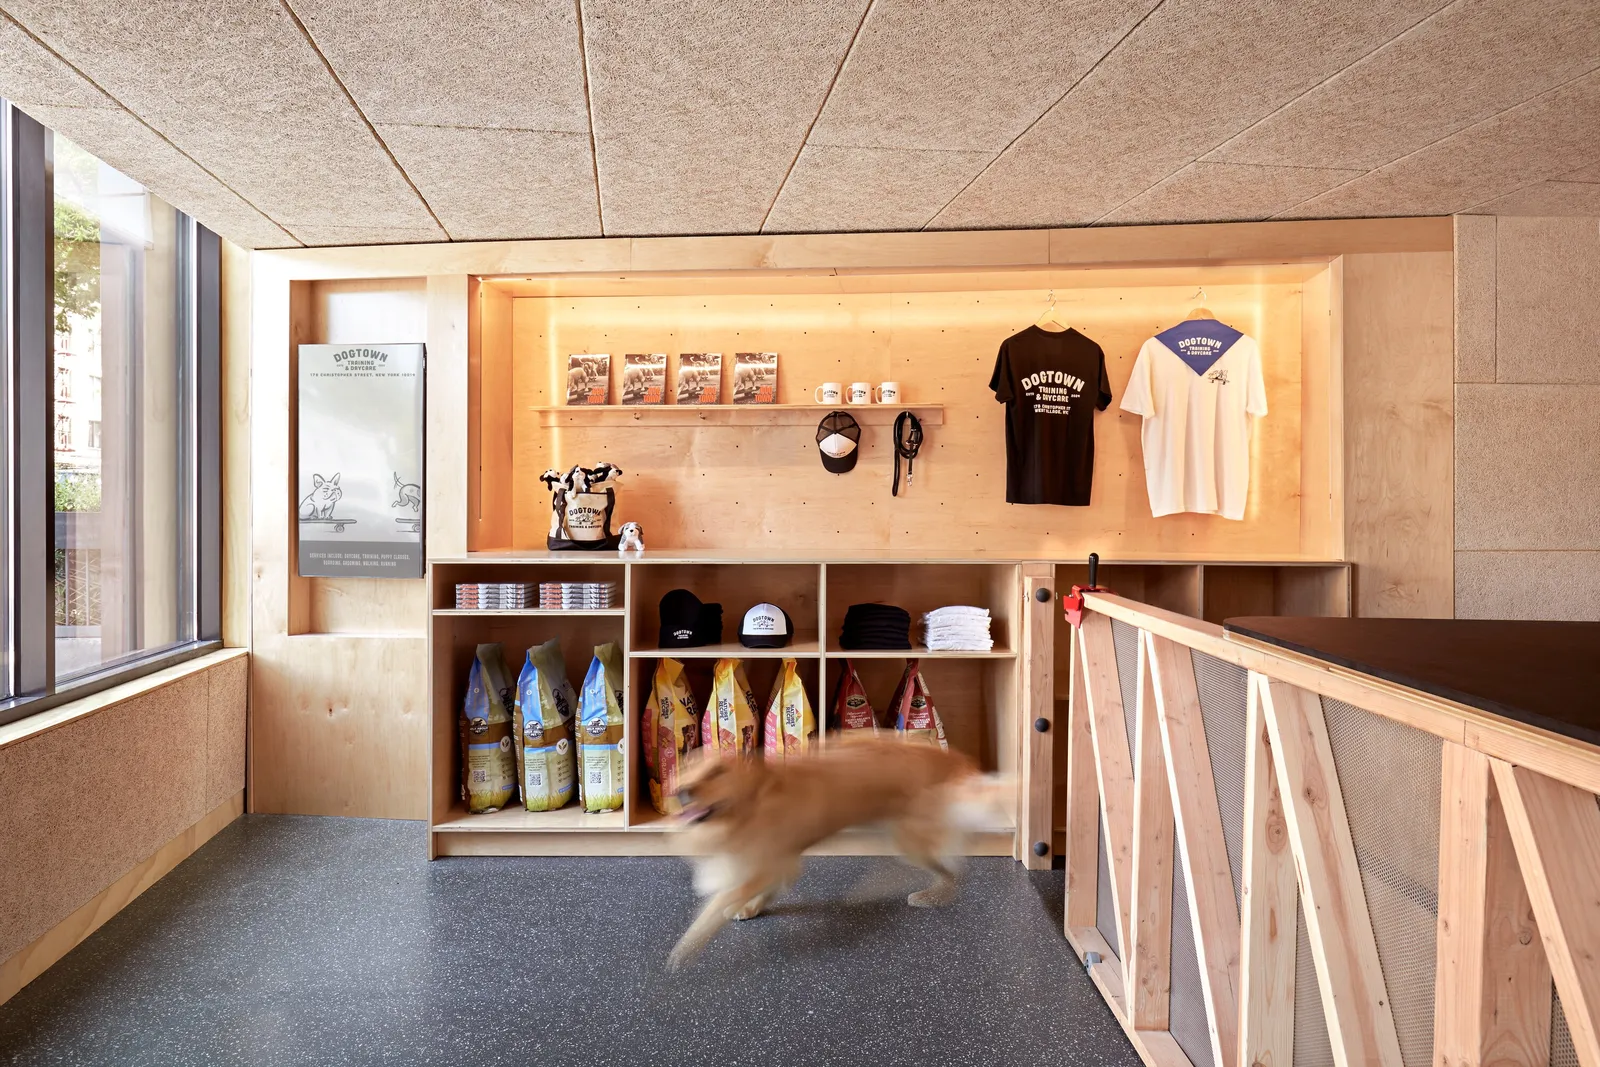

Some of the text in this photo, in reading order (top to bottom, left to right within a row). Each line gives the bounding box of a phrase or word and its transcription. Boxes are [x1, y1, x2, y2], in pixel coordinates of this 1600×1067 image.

[1178, 337, 1222, 348] DOGTOWN
[333, 349, 388, 362] DOGTOWN
[1021, 371, 1085, 392] DOGTOWN
[1038, 386, 1067, 395] TRAINING
